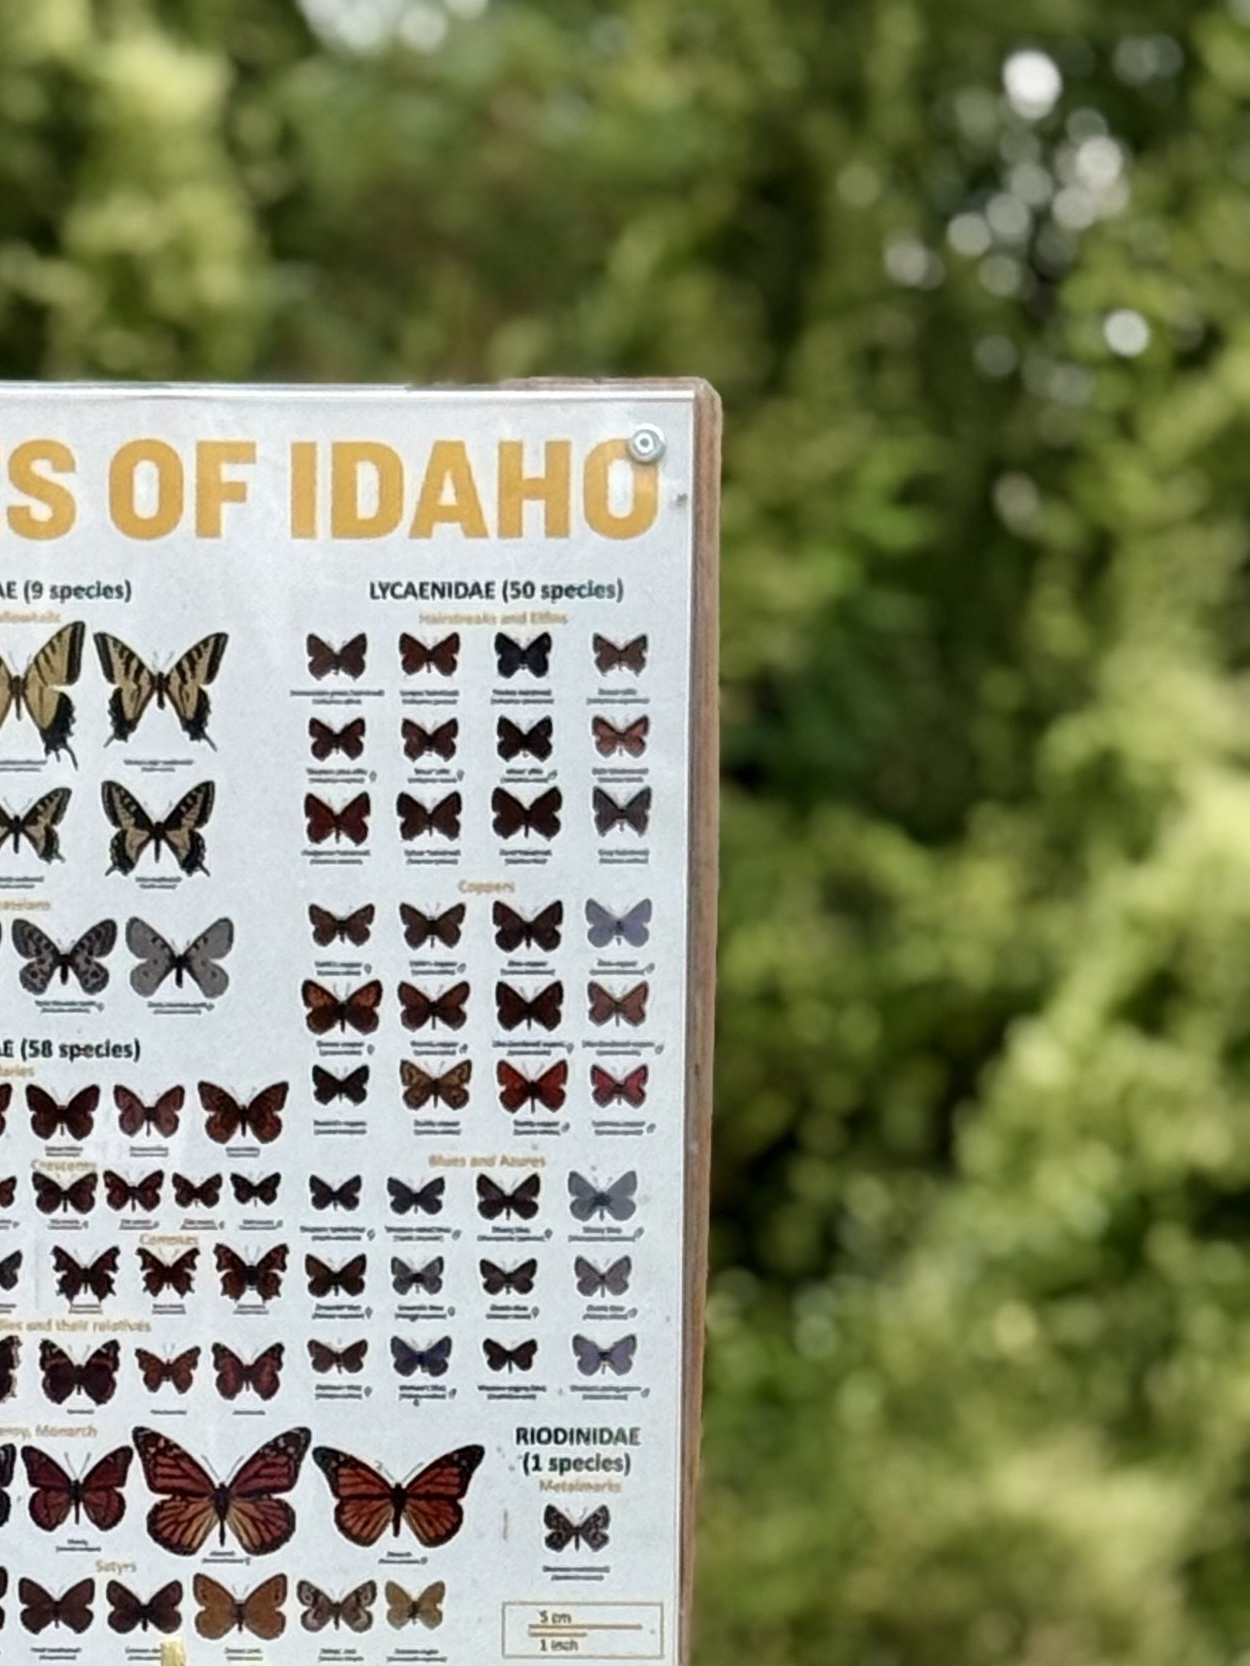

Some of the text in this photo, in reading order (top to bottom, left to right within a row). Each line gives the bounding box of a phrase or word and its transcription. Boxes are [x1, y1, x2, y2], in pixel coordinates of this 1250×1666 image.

[108, 438, 257, 541] OF
[290, 438, 660, 541] IDAHO
[23, 580, 44, 604] (9
[49, 580, 132, 604] species)
[369, 578, 625, 604] LYCAENIDAE (50 species)
[458, 879, 516, 896] Coppers
[20, 1038, 54, 1061] (58
[58, 1038, 141, 1062] species)
[470, 1154, 497, 1169] and
[26, 1318, 53, 1332] and
[515, 1427, 642, 1446] RIODINIDAE
[523, 1452, 632, 1477] (1 species)
[94, 1559, 138, 1576] Satyrs
[539, 1611, 572, 1624] 5 cm
[540, 1639, 548, 1652] 1
